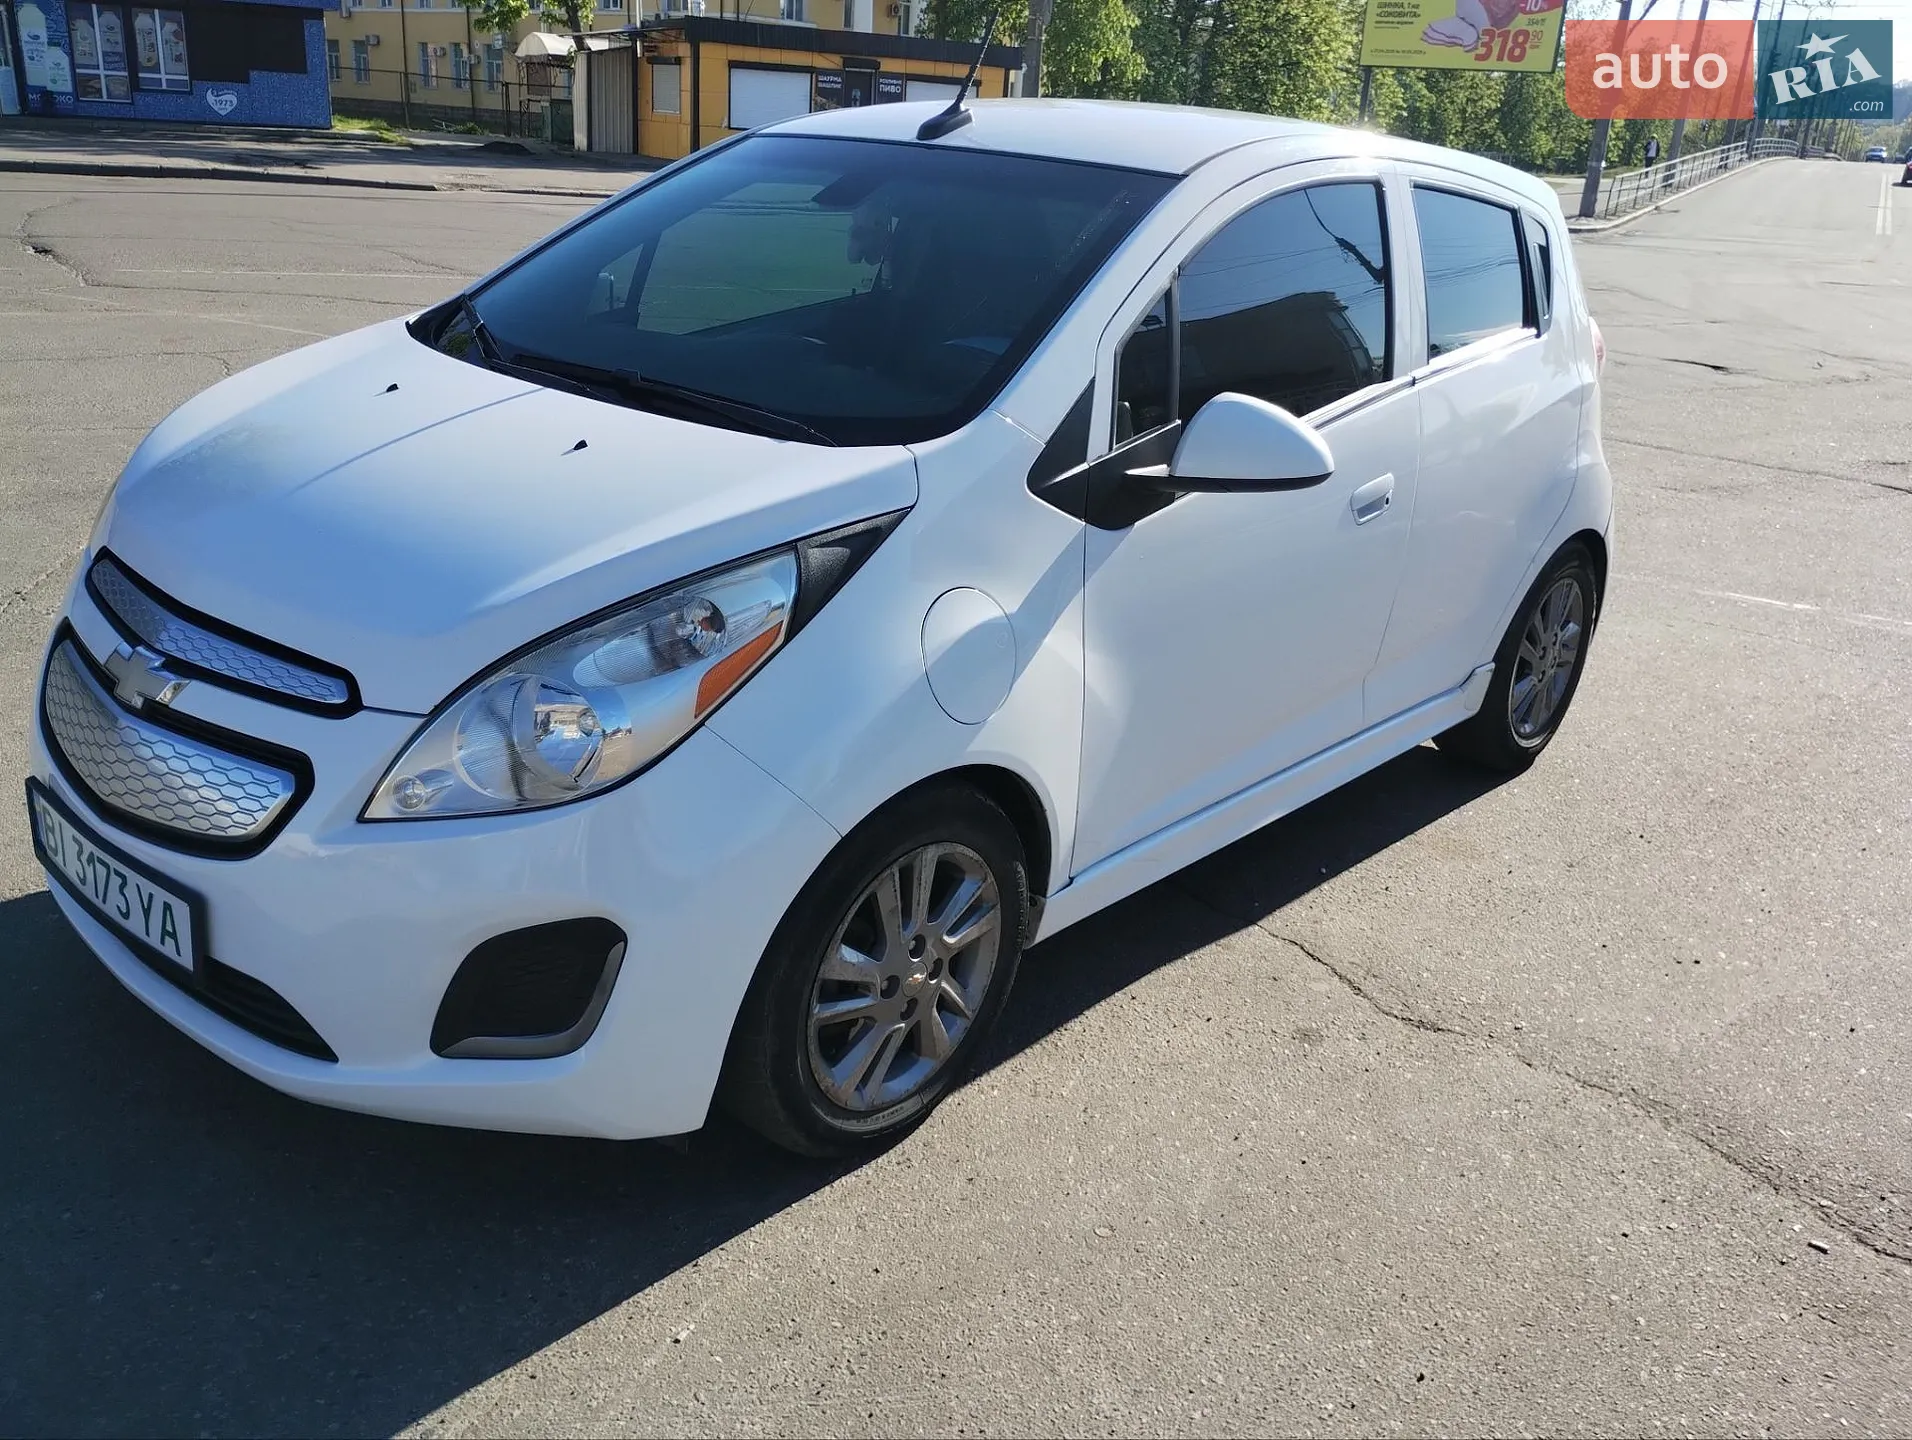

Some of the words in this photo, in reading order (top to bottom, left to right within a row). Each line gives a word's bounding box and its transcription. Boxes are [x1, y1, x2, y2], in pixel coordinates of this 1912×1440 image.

[1474, 28, 1530, 62] 318
[879, 85, 901, 93] ПИВО
[72, 833, 130, 921] 3173
[136, 883, 181, 957] YA
